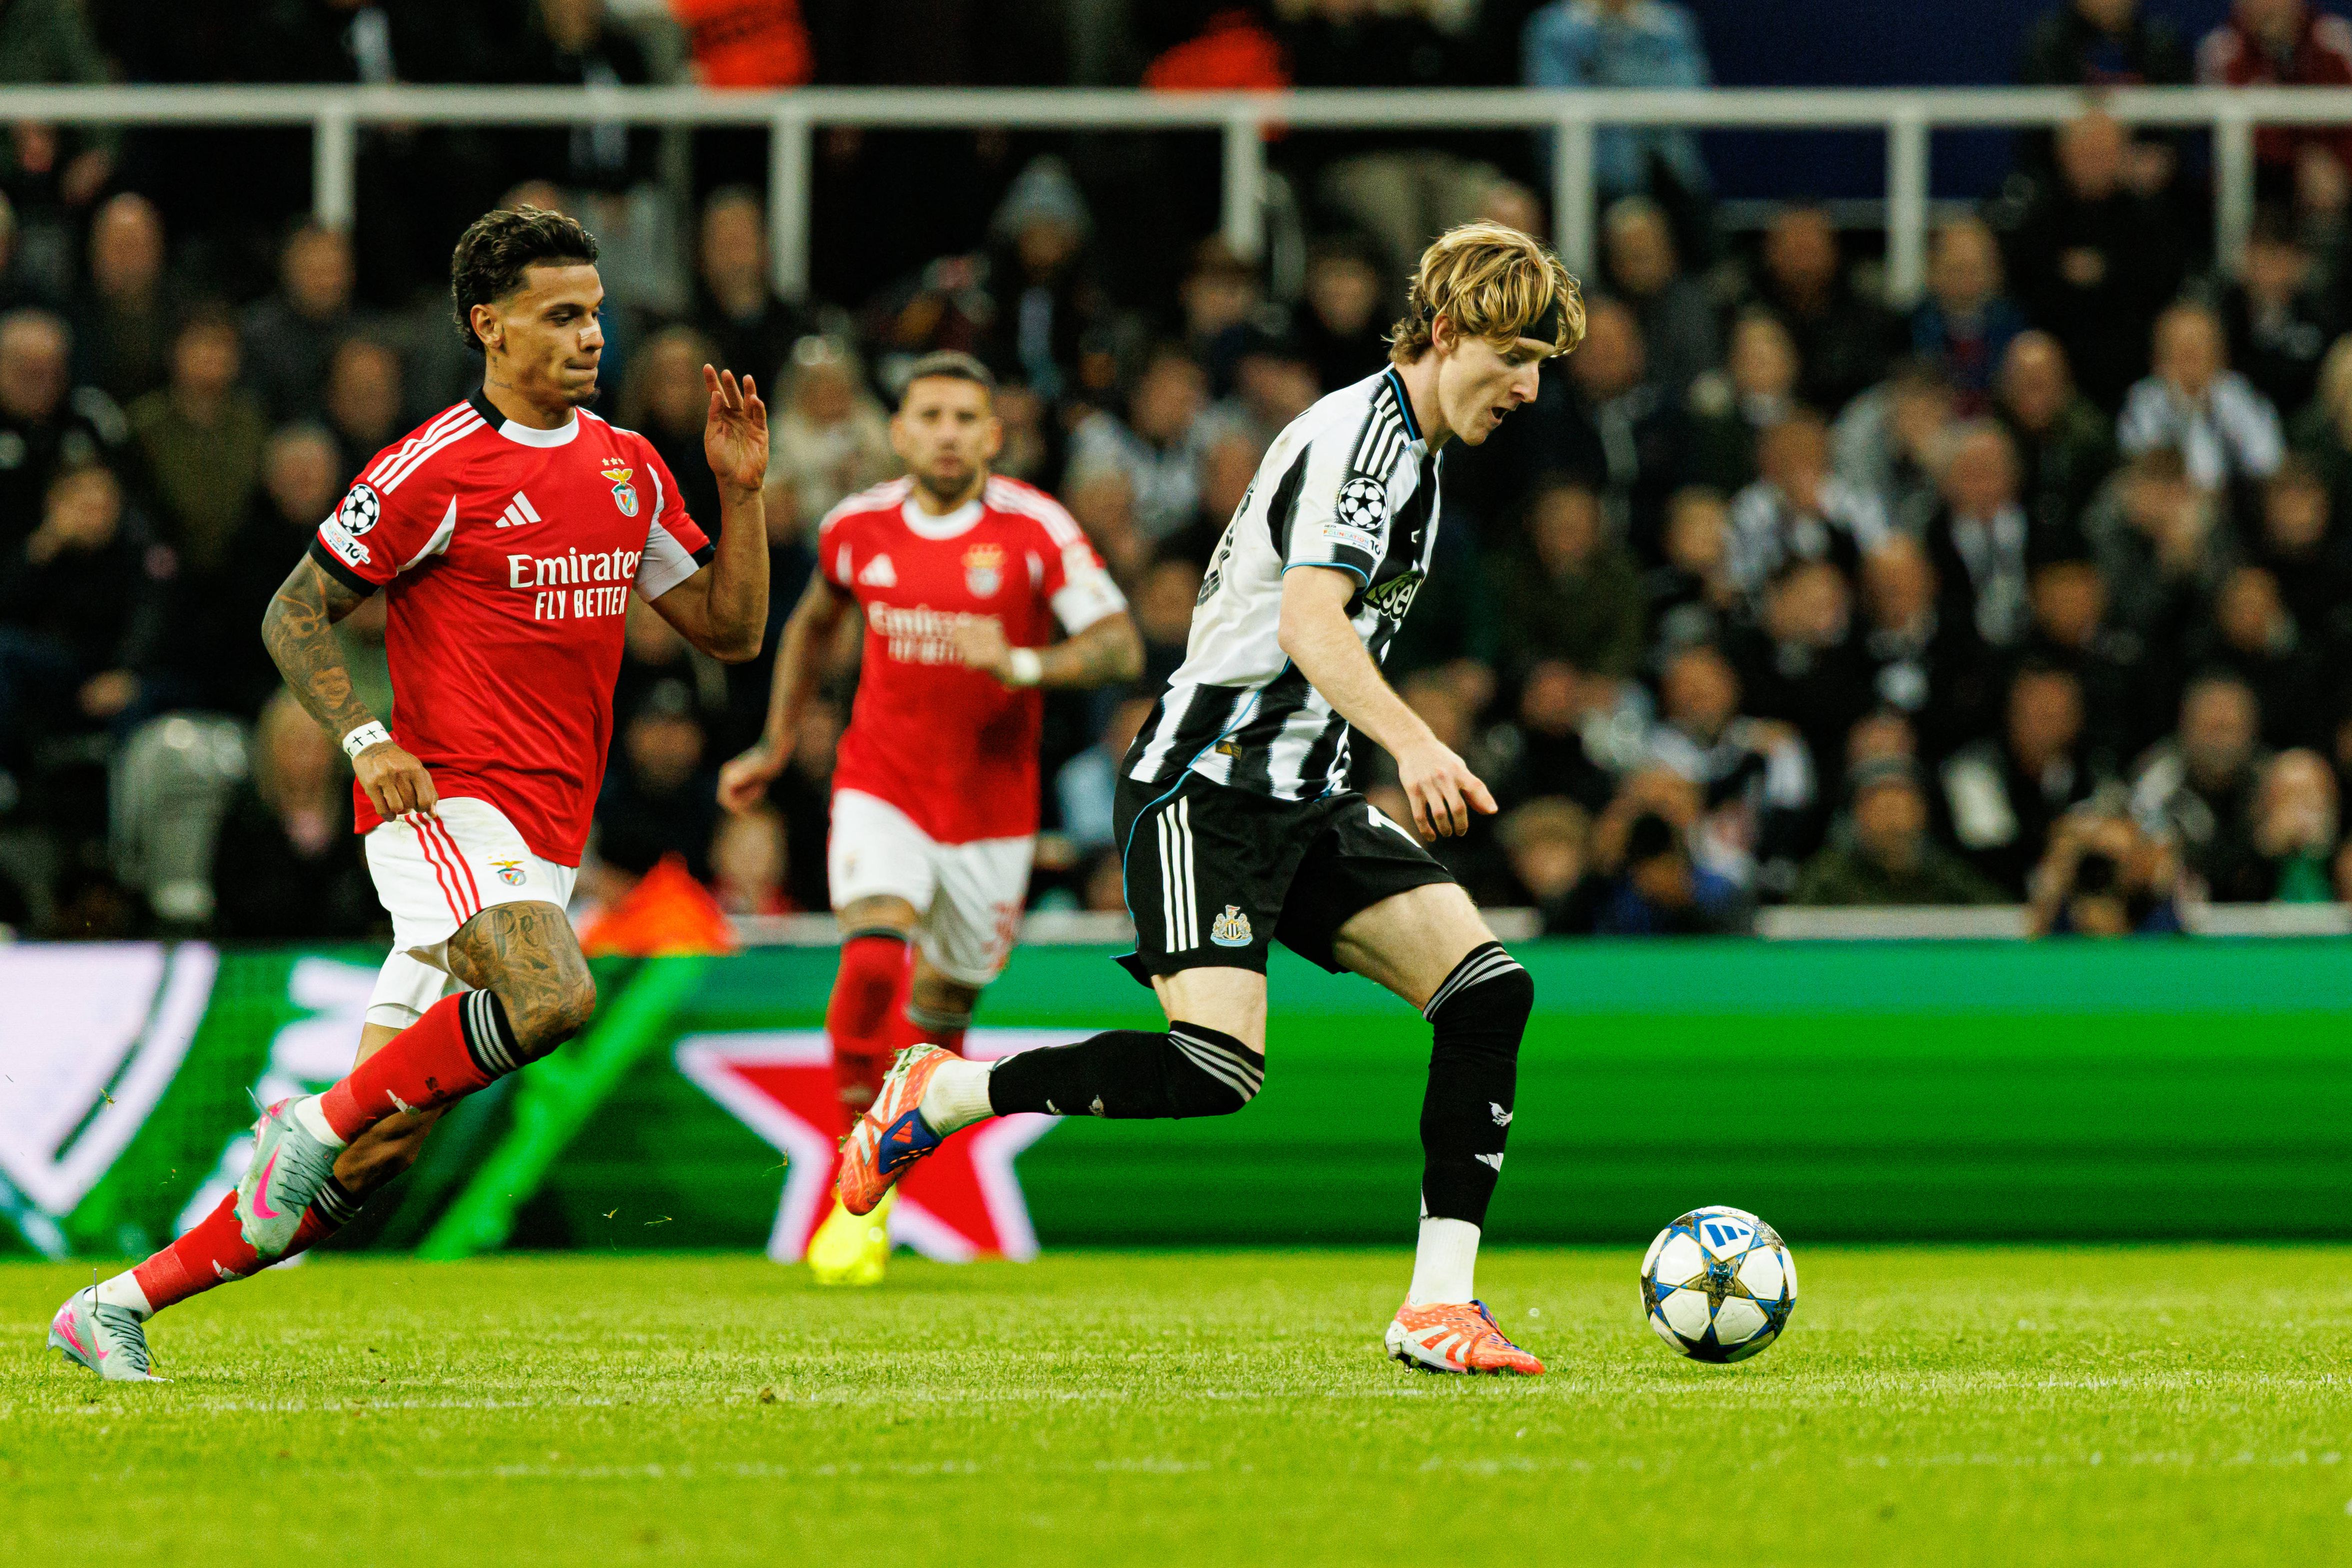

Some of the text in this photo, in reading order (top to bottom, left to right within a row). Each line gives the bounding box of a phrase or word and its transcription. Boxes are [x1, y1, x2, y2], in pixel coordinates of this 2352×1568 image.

[1324, 530, 1369, 546] FOUNDATION
[506, 546, 642, 588] Emirates
[535, 586, 627, 620] FLY BETTER
